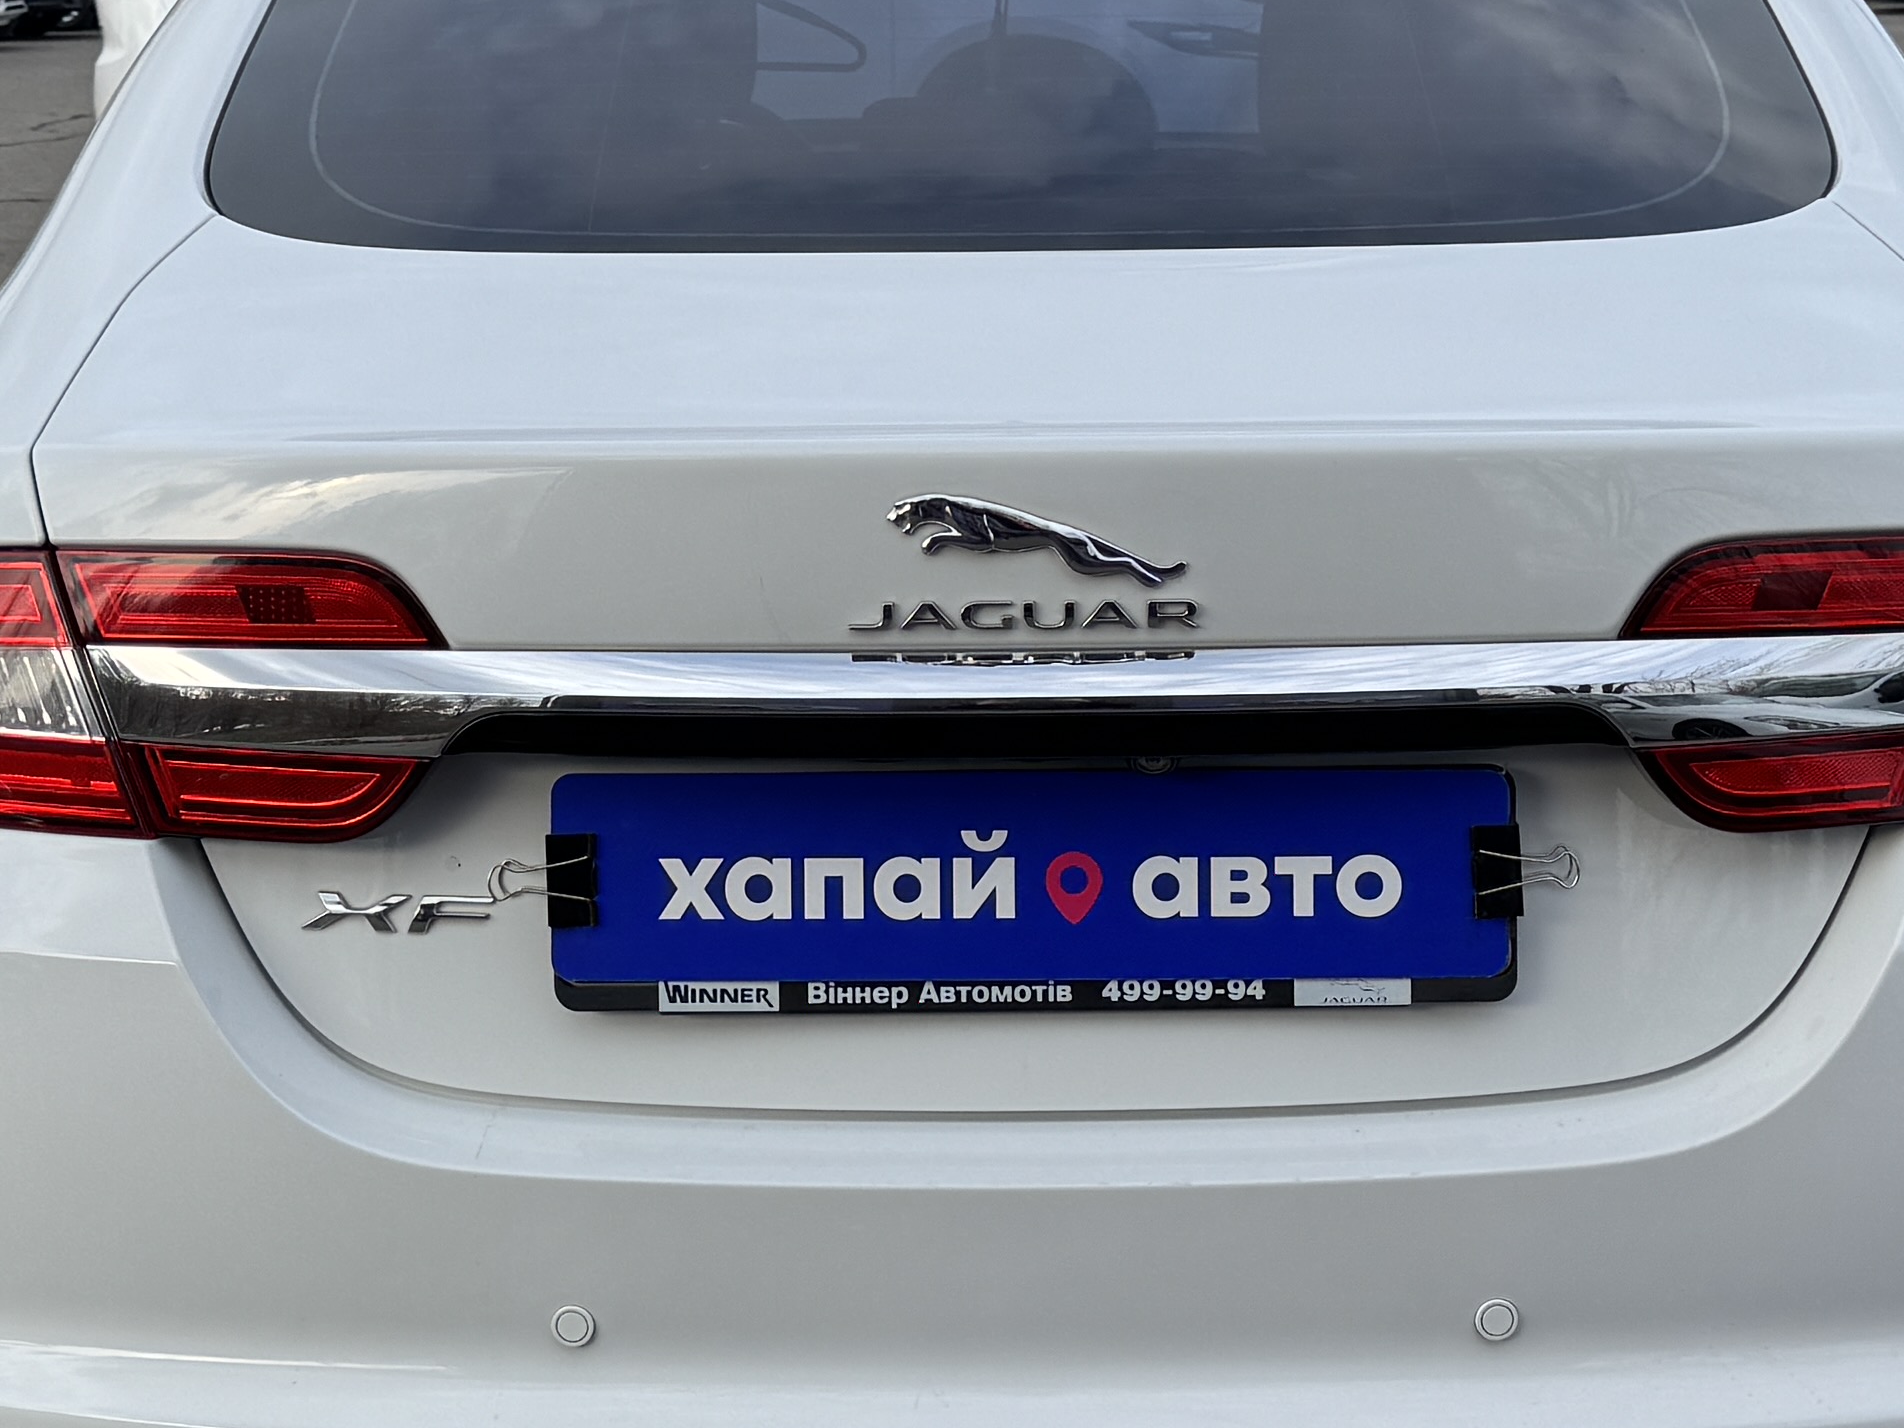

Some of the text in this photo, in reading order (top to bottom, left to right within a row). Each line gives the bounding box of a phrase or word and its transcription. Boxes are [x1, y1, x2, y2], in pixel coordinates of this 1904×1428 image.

[848, 599, 1199, 630] JAGUAR
[658, 829, 1403, 921] хапай авто
[301, 890, 494, 935] XF
[806, 980, 1074, 1009] Віннер Автомотів
[1101, 979, 1267, 1002] 499-99-94
